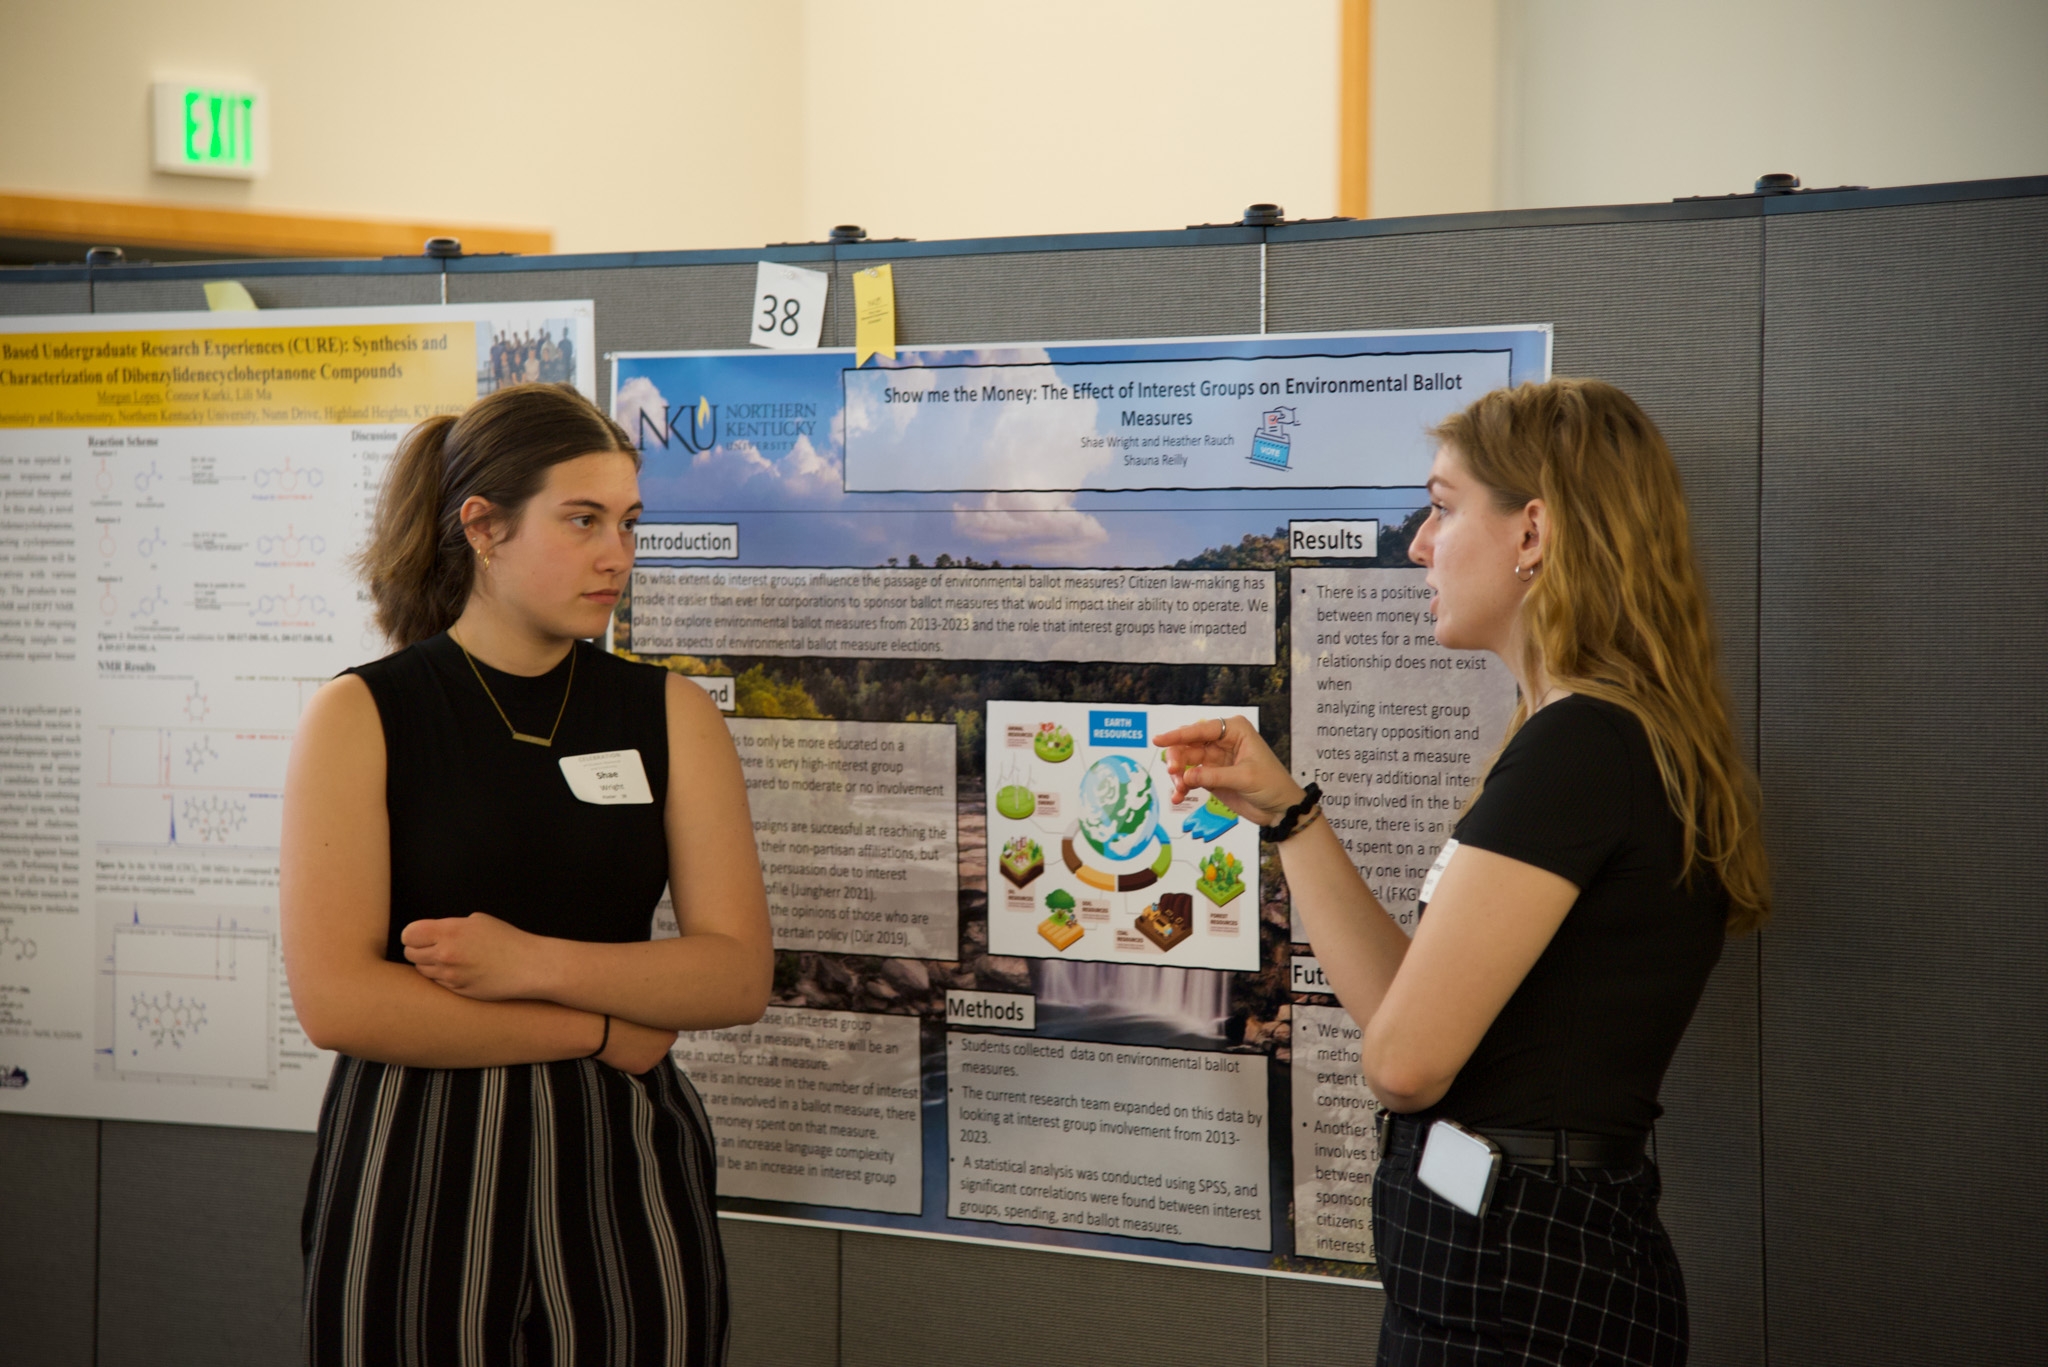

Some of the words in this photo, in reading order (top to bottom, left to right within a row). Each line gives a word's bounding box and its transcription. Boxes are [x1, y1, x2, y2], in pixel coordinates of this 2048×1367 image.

[182, 90, 254, 164] EXIT
[759, 294, 800, 336] 38
[2, 343, 38, 358] Based
[42, 341, 136, 361] Undergraduate
[141, 340, 199, 357] Research
[204, 338, 284, 360] Experiences
[288, 336, 348, 356] (CURE):
[352, 334, 416, 356] Synthesis
[422, 333, 446, 349] and
[106, 367, 118, 383] of
[319, 361, 401, 383] Compounds
[884, 387, 922, 403] Show
[928, 390, 949, 402] me
[953, 385, 976, 401] the
[982, 384, 1036, 405] Money:
[1040, 383, 1067, 400] The
[1073, 381, 1113, 399] Effect
[1118, 381, 1133, 398] of
[1138, 381, 1195, 397] Interest
[1200, 379, 1254, 399] Groups
[1259, 382, 1279, 394] on
[1286, 373, 1406, 394] Environmental
[1413, 372, 1462, 390] Ballot
[726, 400, 816, 422] NORTHERN
[1122, 408, 1192, 427] Measures
[352, 430, 397, 441] Discussion
[638, 405, 717, 454] NKU
[726, 418, 816, 439] KENTUCKY
[88, 436, 124, 447] Reaction
[127, 436, 159, 447] Scheme
[726, 441, 796, 450] UNIVERSITY
[1081, 436, 1104, 447] Shae
[1106, 436, 1138, 450] Wright
[1141, 435, 1159, 446] and
[1162, 435, 1201, 446] Heather
[1204, 434, 1234, 445] Rauch
[1124, 454, 1158, 465] Shauna
[1162, 454, 1187, 467] Reilly
[635, 532, 731, 550] Introduction
[1293, 530, 1362, 550] Results
[634, 572, 647, 585] To
[651, 573, 675, 585] what
[679, 573, 710, 585] extent
[713, 573, 725, 585] do
[729, 573, 767, 585] interest
[771, 577, 806, 589] groups
[809, 574, 860, 586] influence
[863, 574, 880, 586] the
[884, 578, 927, 590] passage
[931, 575, 942, 587] of
[945, 575, 1025, 587] environmental
[1030, 575, 1060, 588] ballot
[1064, 576, 1125, 588] measures?
[1129, 576, 1166, 589] Citizen
[1171, 576, 1239, 592] law-making
[1244, 577, 1265, 589] has
[1318, 585, 1353, 598] There
[1357, 586, 1366, 598] is
[1370, 589, 1377, 599] a
[1381, 586, 1431, 604] positive
[633, 615, 658, 629] plan
[661, 615, 671, 626] to
[675, 615, 711, 630] explore
[715, 616, 789, 628] environmental
[792, 617, 821, 628] ballot
[825, 620, 876, 629] measures
[880, 618, 906, 629] from
[910, 618, 969, 630] 2013-2023
[973, 619, 993, 630] and
[997, 619, 1014, 631] the
[1018, 619, 1039, 631] role
[1043, 620, 1066, 631] that
[1069, 620, 1112, 632] interest
[1115, 624, 1155, 636] groups
[1158, 621, 1186, 633] have
[1190, 621, 1246, 637] impacted
[1317, 654, 1391, 670] relationship
[1395, 654, 1425, 668] does
[1430, 657, 1451, 669] not
[1455, 656, 1486, 669] exist
[1317, 677, 1351, 690] when
[1317, 700, 1375, 717] analyzing
[1379, 701, 1427, 715] interest
[1431, 705, 1470, 719] group
[1104, 718, 1132, 728] EARTH
[1317, 724, 1377, 740] monetary
[1381, 725, 1450, 741] opposition
[1454, 726, 1479, 740] and
[1093, 729, 1143, 739] RESOURCES
[1316, 747, 1350, 759] votes
[1354, 747, 1398, 763] against
[1402, 751, 1409, 761] a
[1413, 752, 1470, 763] measure
[777, 928, 814, 940] certain
[818, 930, 848, 944] policy
[876, 931, 911, 947] 2019).
[948, 998, 1024, 1021] Methods
[961, 1036, 1010, 1054] Students
[1013, 1040, 1064, 1058] collected
[1070, 1046, 1094, 1060] data
[1098, 1051, 1112, 1062] on
[1116, 1050, 1201, 1070] environmental
[1204, 1056, 1239, 1073] ballot
[962, 1063, 1018, 1076] measures.
[1317, 1072, 1357, 1086] extent
[961, 1085, 981, 1099] The
[985, 1089, 1026, 1103] current
[1030, 1091, 1077, 1108] research
[1080, 1097, 1109, 1110] team
[1113, 1098, 1170, 1118] expanded
[1173, 1107, 1187, 1118] on
[1191, 1105, 1213, 1120] this
[1217, 1107, 1243, 1122] data
[1247, 1109, 1262, 1127] by
[716, 1117, 752, 1131] money
[755, 1117, 785, 1134] spent
[789, 1123, 801, 1132] on
[806, 1121, 826, 1134] that
[830, 1126, 879, 1138] measure.
[721, 1137, 733, 1147] an
[739, 1137, 781, 1151] increase
[785, 1141, 832, 1158] language
[835, 1144, 894, 1165] complexity
[1314, 1144, 1367, 1161] involves
[1315, 1168, 1372, 1184] between
[1316, 1237, 1365, 1254] interest
